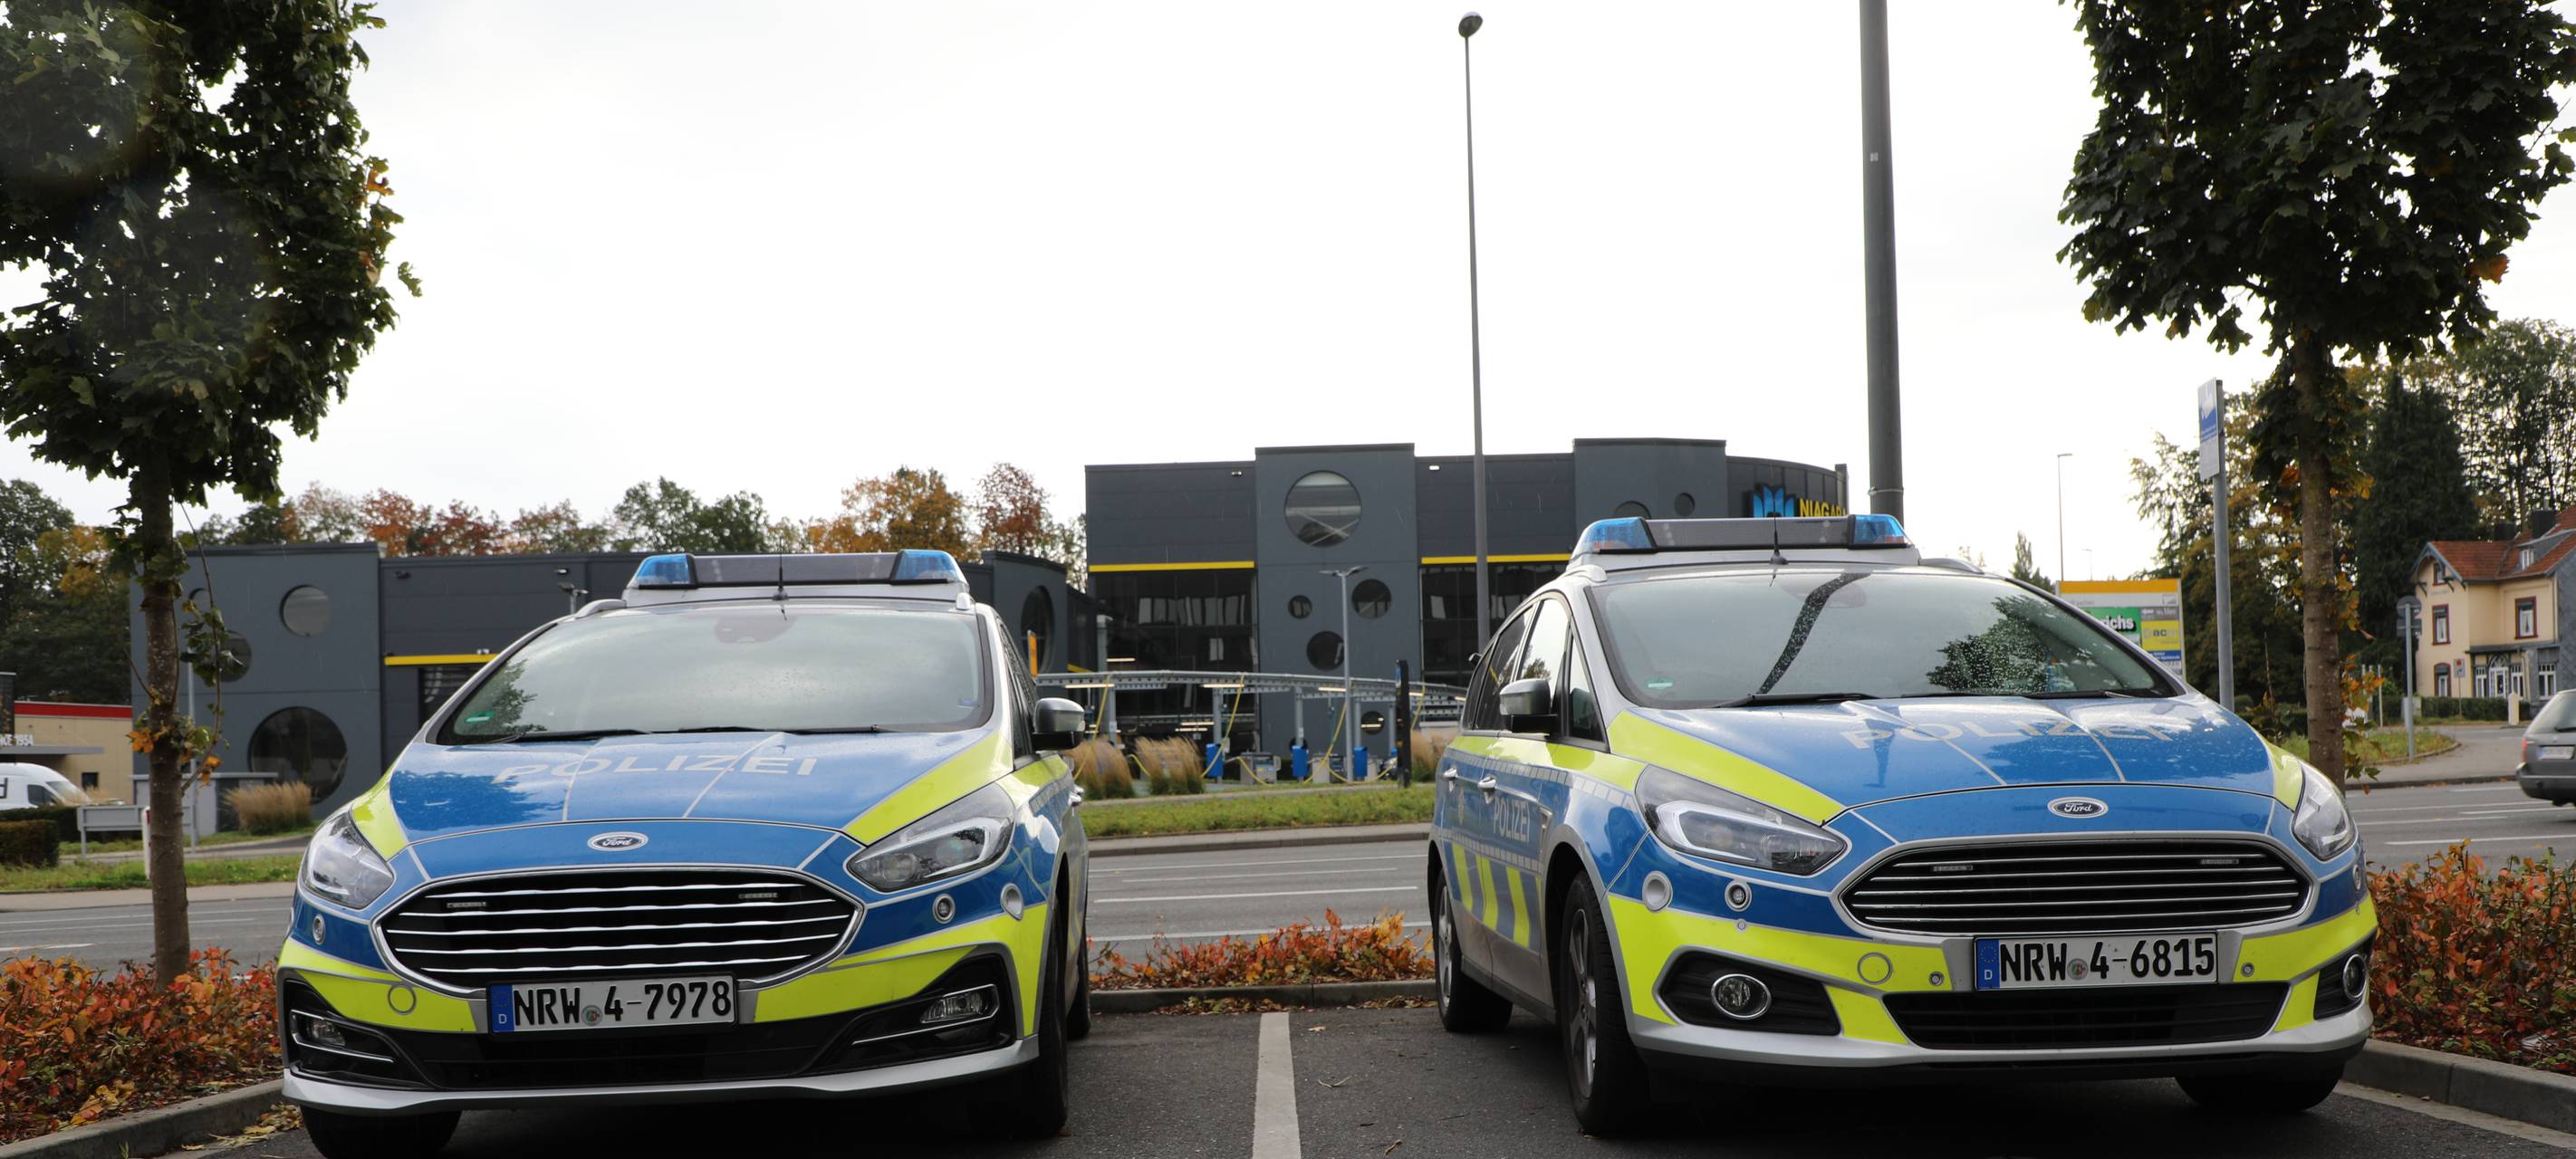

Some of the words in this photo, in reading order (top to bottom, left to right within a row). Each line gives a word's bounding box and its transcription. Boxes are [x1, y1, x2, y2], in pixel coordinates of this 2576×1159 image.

[1840, 720, 2174, 750] POLIZEI
[491, 754, 818, 785] POLIZEI
[1493, 796, 1531, 844] POLIZEI
[2063, 802, 2093, 813] Ford
[1984, 969, 1994, 981] D
[1999, 942, 2068, 982] NRW
[2090, 937, 2215, 980] 4-6815
[497, 1013, 508, 1025] D
[513, 987, 581, 1026] NRW
[603, 981, 732, 1022] 4-7978
